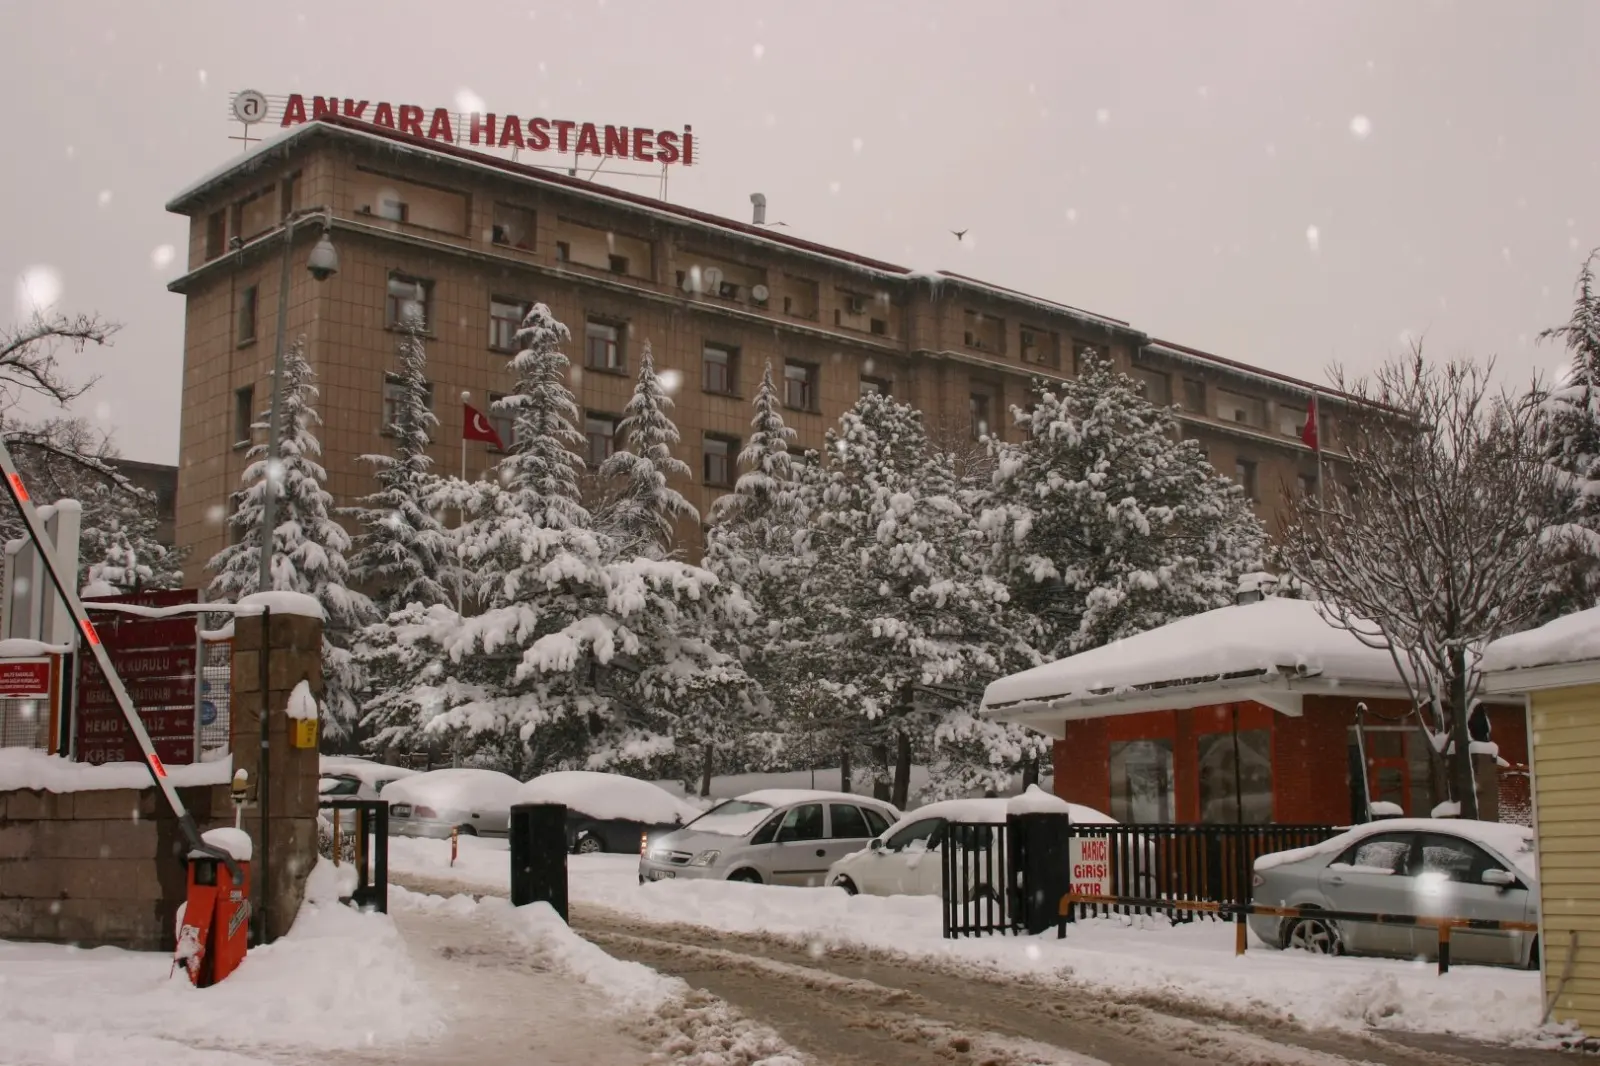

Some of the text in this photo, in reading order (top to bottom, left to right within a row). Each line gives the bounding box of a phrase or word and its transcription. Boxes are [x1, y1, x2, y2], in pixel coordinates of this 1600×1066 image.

[280, 94, 694, 165] ANKARA HASTANESİ
[129, 657, 170, 672] KURULU
[85, 719, 118, 733] HEMO
